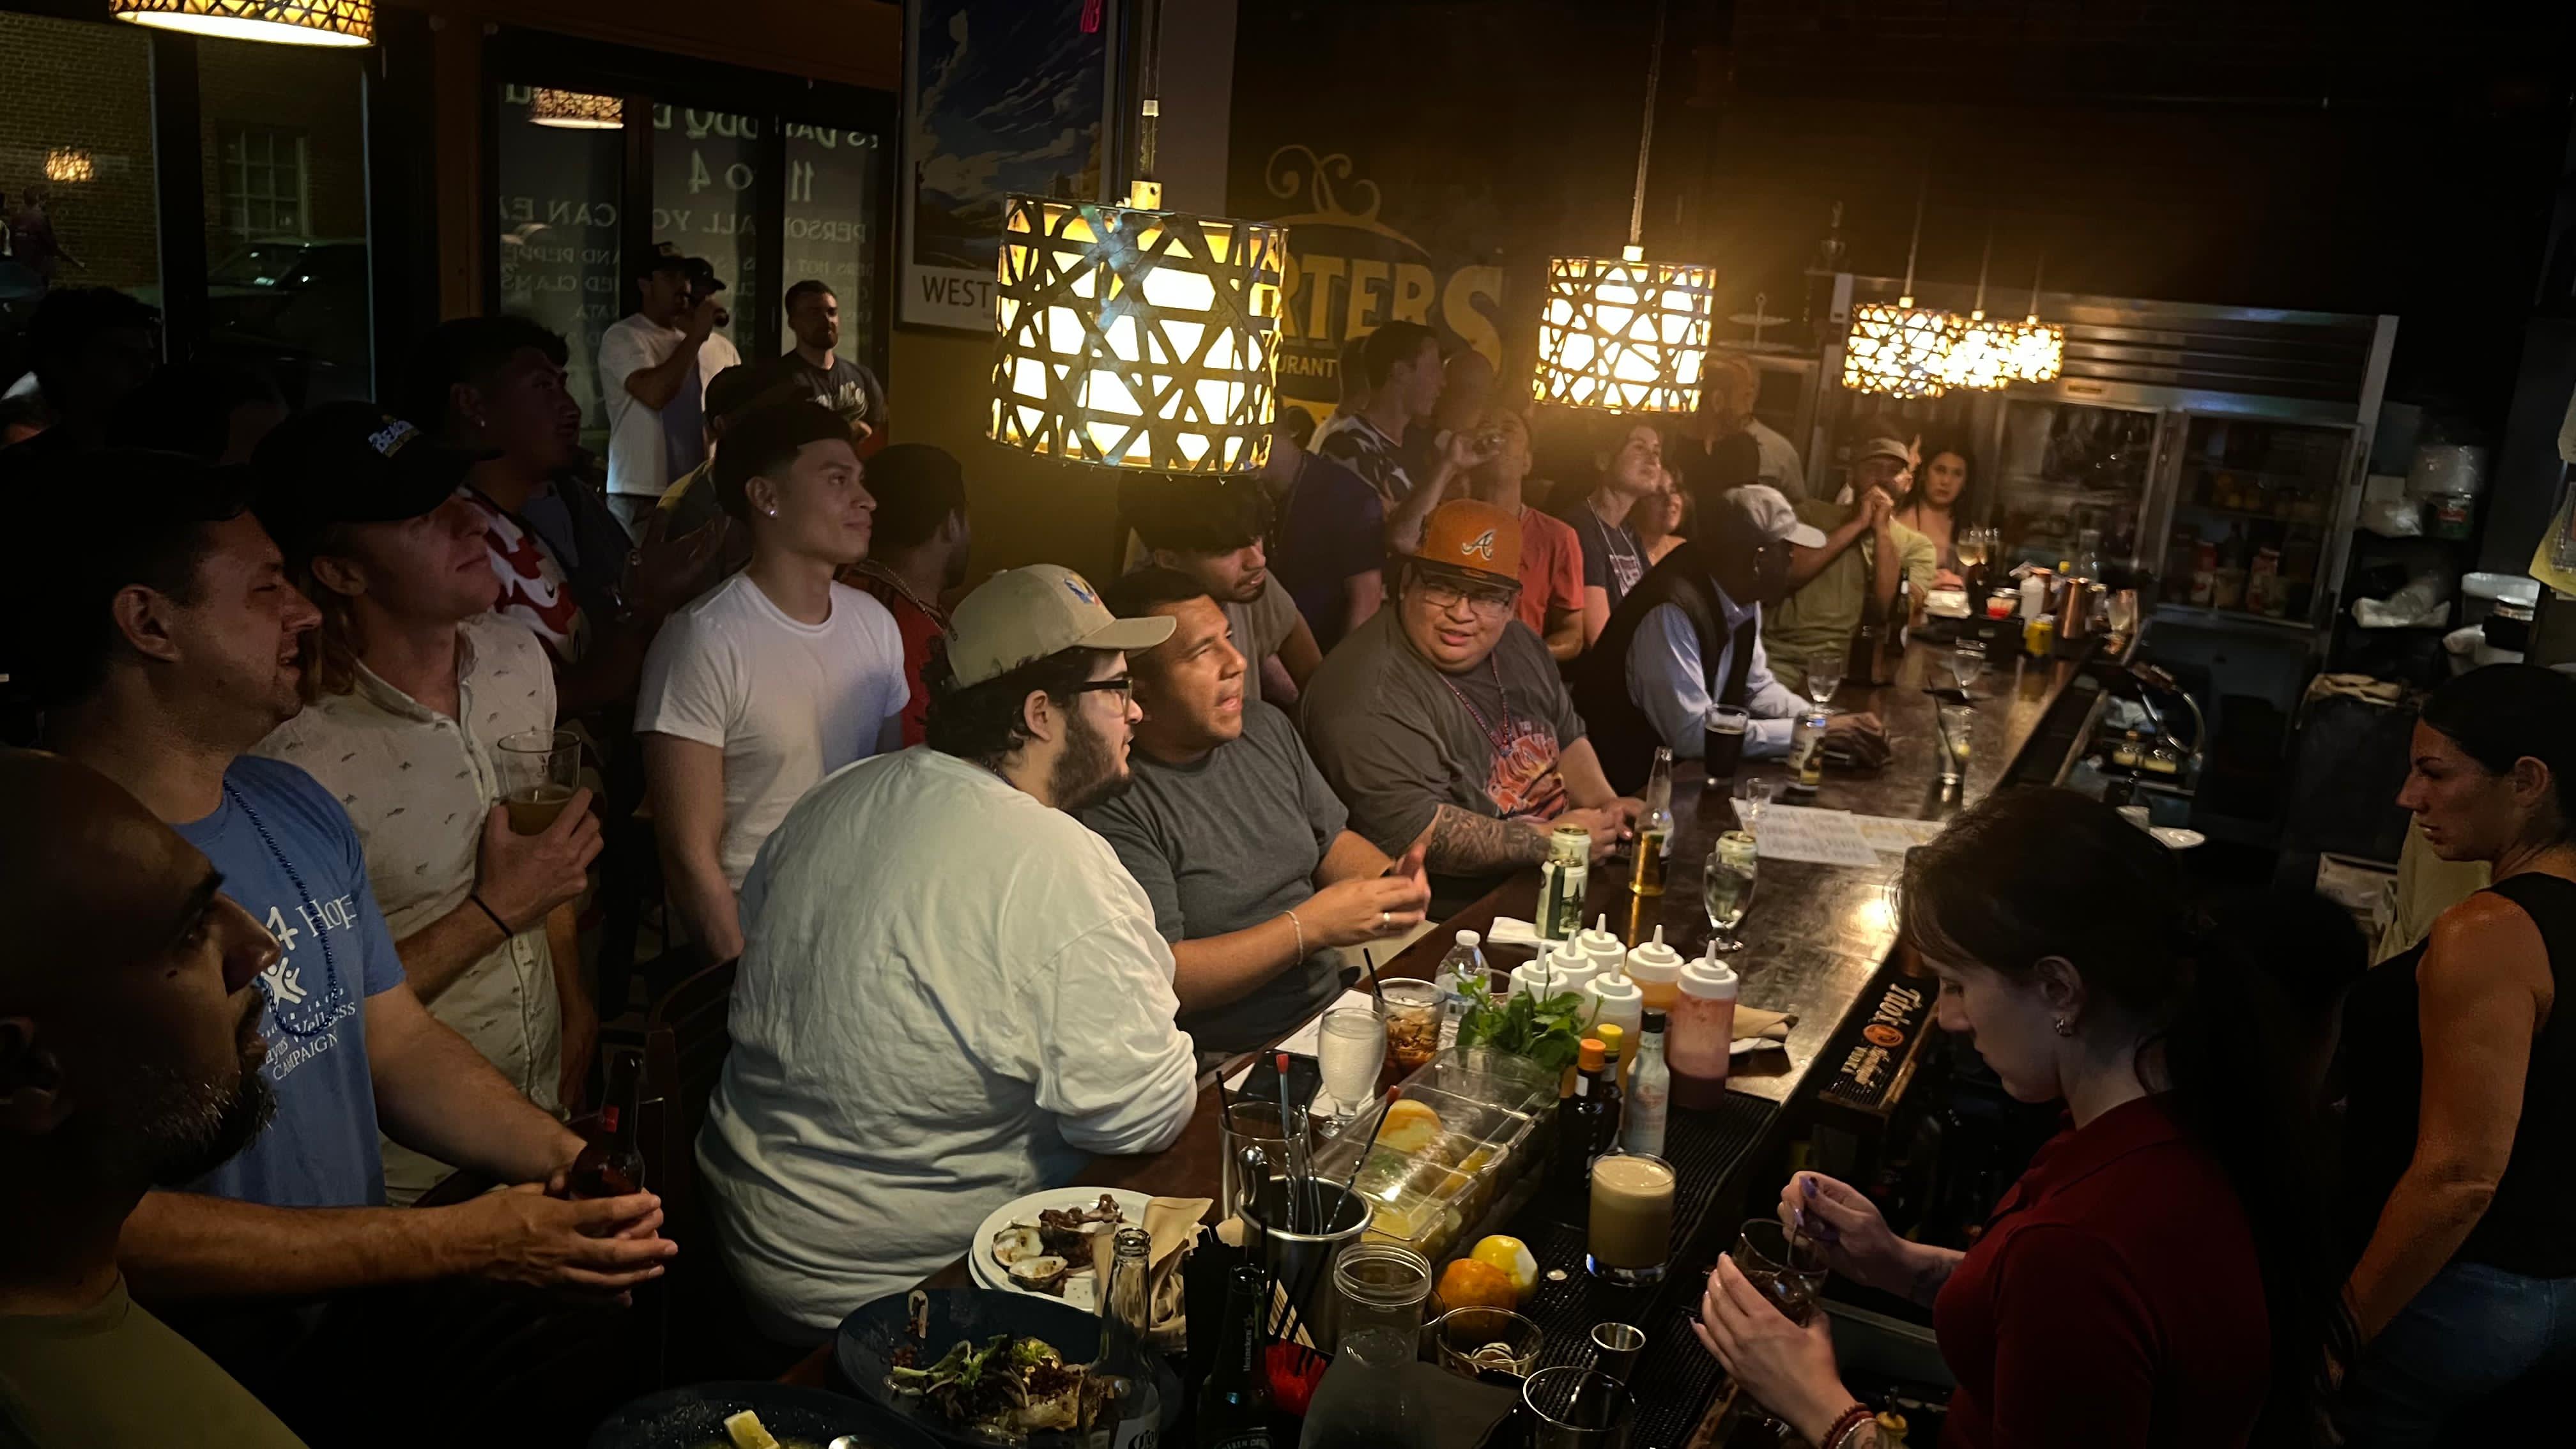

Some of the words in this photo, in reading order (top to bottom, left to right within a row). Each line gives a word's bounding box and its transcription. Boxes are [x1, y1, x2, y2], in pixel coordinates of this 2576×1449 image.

[922, 275, 992, 308] WEST
[1280, 252, 1504, 377] RTERS
[1277, 352, 1338, 378] URANT
[1461, 529, 1497, 561] A
[266, 906, 298, 951] 4
[273, 1031, 338, 1080] CAMPAIGN
